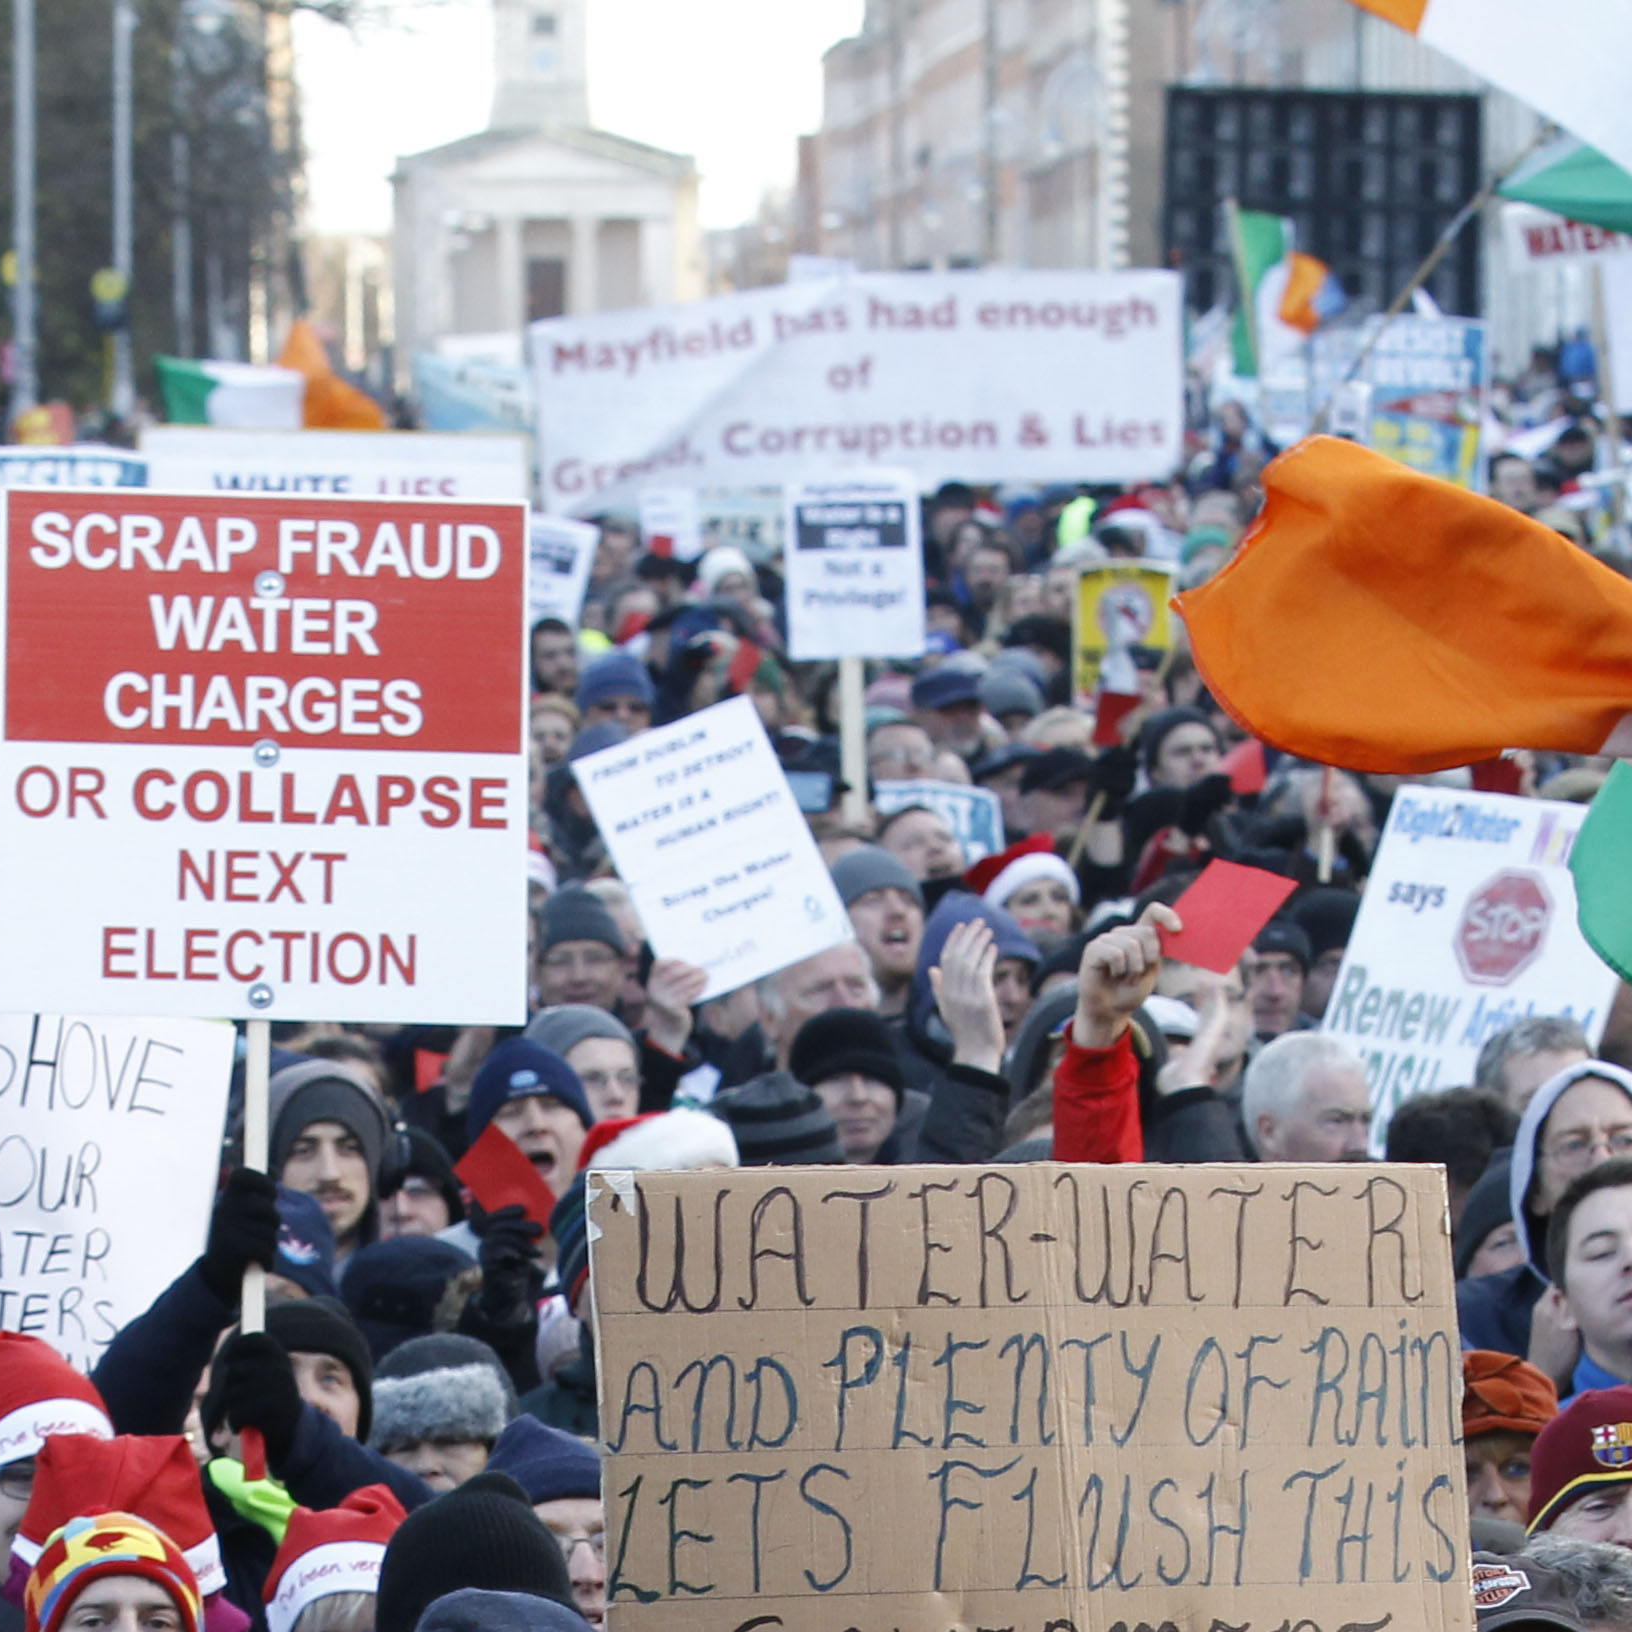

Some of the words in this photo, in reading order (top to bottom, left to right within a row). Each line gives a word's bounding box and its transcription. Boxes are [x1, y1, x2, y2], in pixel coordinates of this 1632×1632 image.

[551, 316, 757, 378] Mayfield
[774, 303, 849, 344] has
[868, 295, 958, 331] had
[977, 298, 1158, 339] enough
[827, 356, 875, 391] of
[722, 412, 998, 459] Corruption
[1018, 413, 1052, 448] &
[1074, 412, 1165, 450] Lies
[29, 512, 258, 573] SCRAP
[277, 519, 502, 580] FRAUD
[149, 593, 380, 656] WATER
[102, 671, 424, 736] CHARGES
[592, 755, 640, 782] FROM
[644, 729, 708, 762] DUBLIN
[14, 764, 108, 820] OR
[132, 766, 510, 830] COLLAPSE
[615, 802, 674, 833] WATER
[177, 850, 348, 904] NEXT
[1388, 878, 1447, 912] says
[1468, 896, 1546, 945] STOP
[101, 926, 419, 986] ELECTION
[1331, 965, 1462, 1044] Renew
[606, 1354, 798, 1453] AND
[821, 1323, 1160, 1452] PLENTY
[1182, 1333, 1297, 1452] OF
[606, 1461, 853, 1604] LETS
[929, 1455, 1249, 1594] FLUSH
